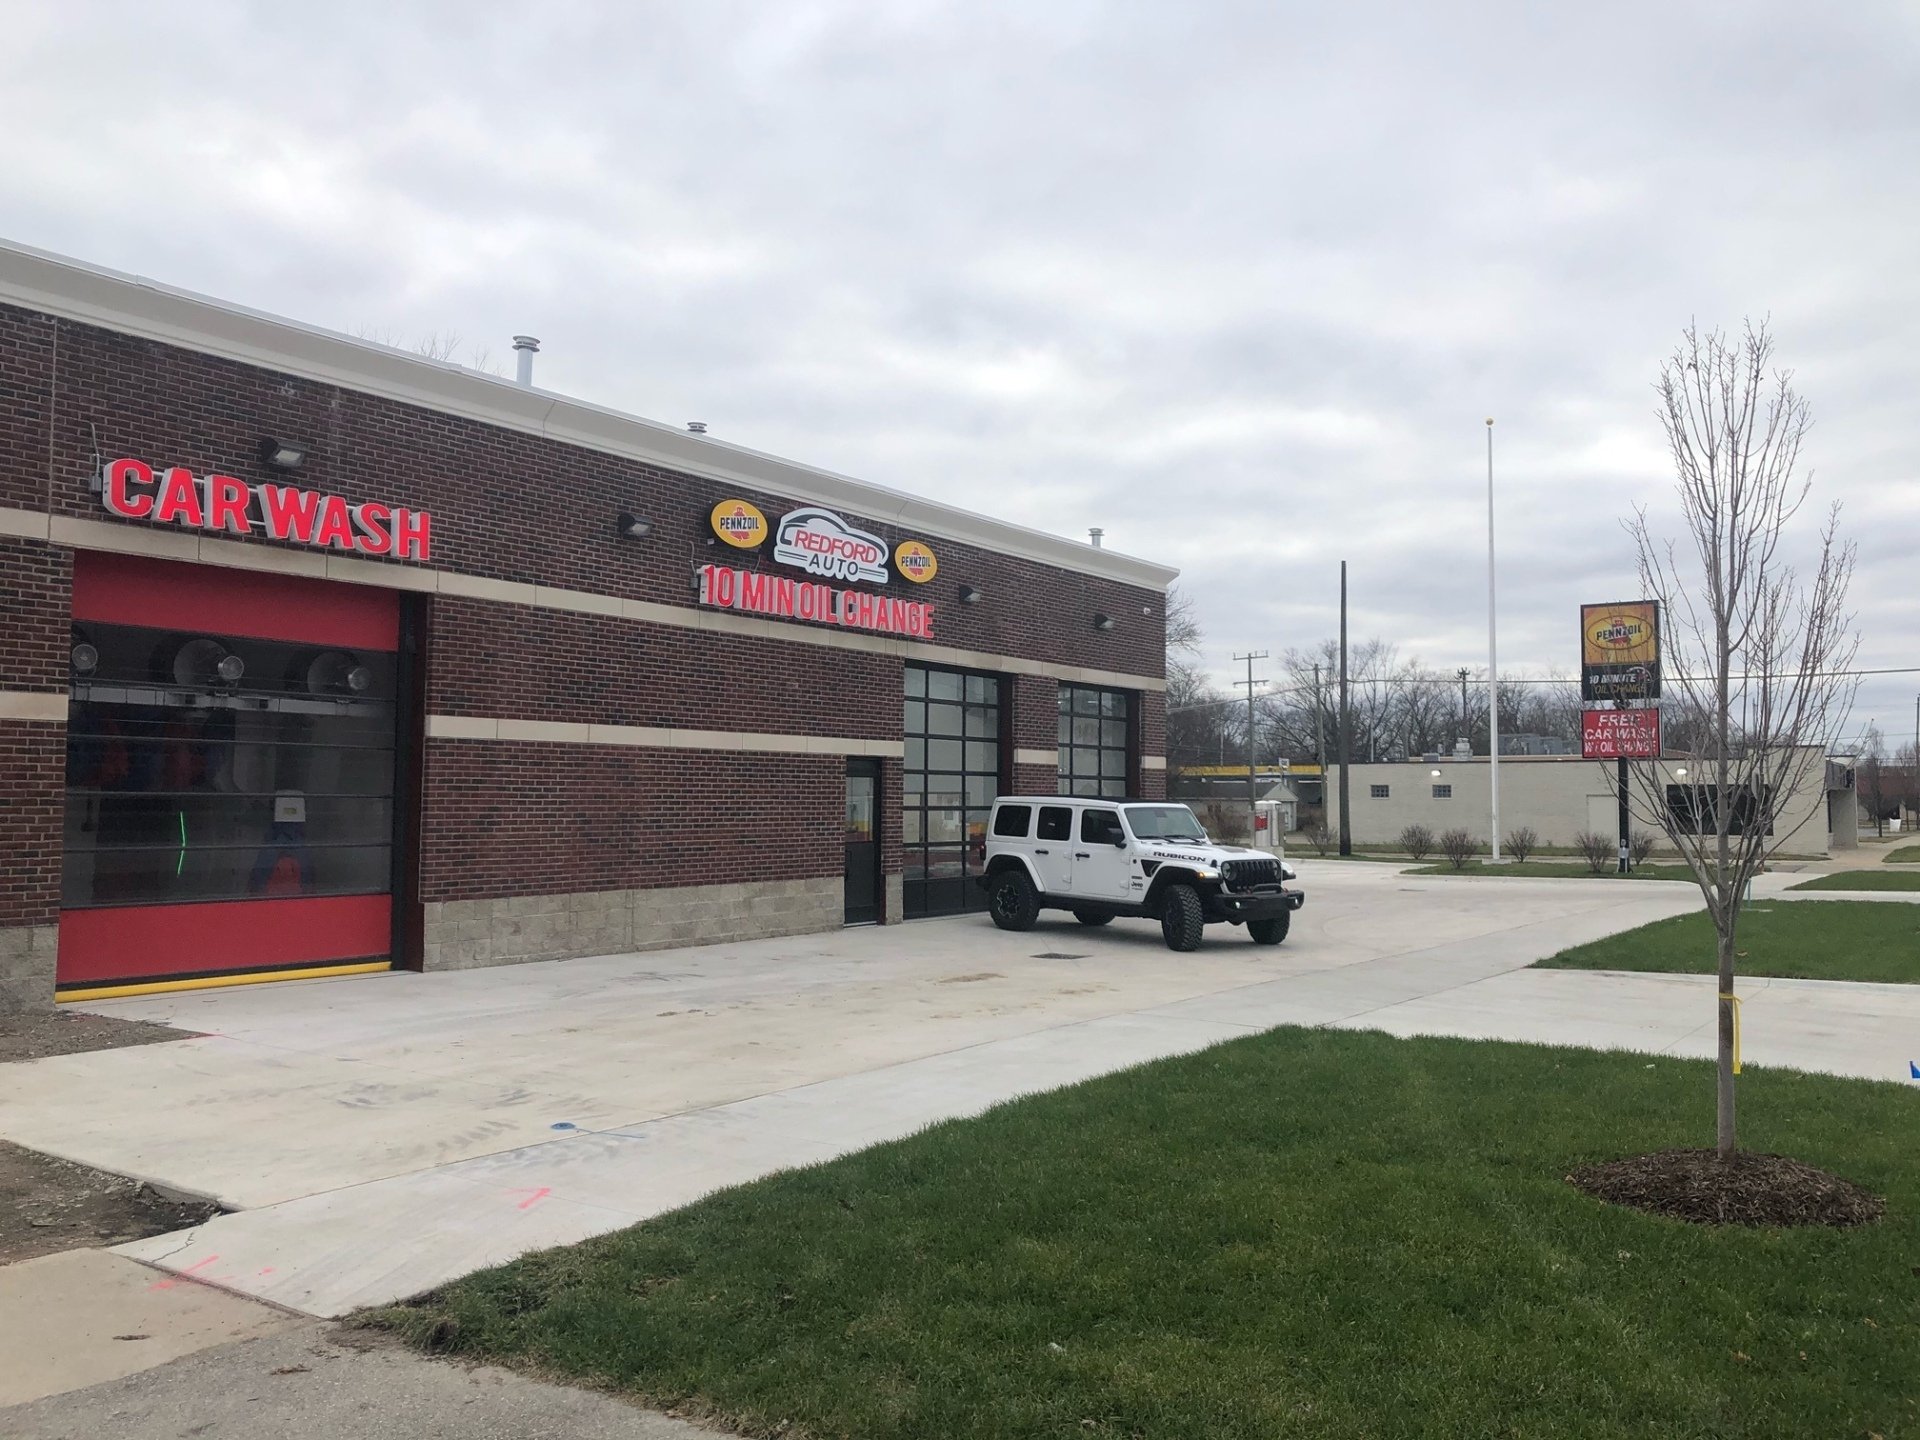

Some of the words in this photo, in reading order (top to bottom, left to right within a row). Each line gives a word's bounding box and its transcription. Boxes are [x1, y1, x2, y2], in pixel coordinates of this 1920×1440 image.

[103, 458, 251, 533] CAR
[257, 484, 431, 560] WASH
[719, 516, 760, 531] PENNZOIL
[794, 529, 877, 564] REDFORD
[809, 553, 859, 576] AUTO
[901, 555, 932, 568] PENNZOIL
[701, 564, 735, 607] 10
[737, 571, 794, 616] MIN
[796, 581, 837, 624] OIL
[837, 590, 934, 638] CHANGE
[1596, 624, 1642, 641] PENNZOIL
[1589, 674, 1600, 685] 10
[1584, 728, 1612, 740] CAR
[1600, 741, 1615, 753] OIL
[1153, 851, 1206, 862] RUBICON
